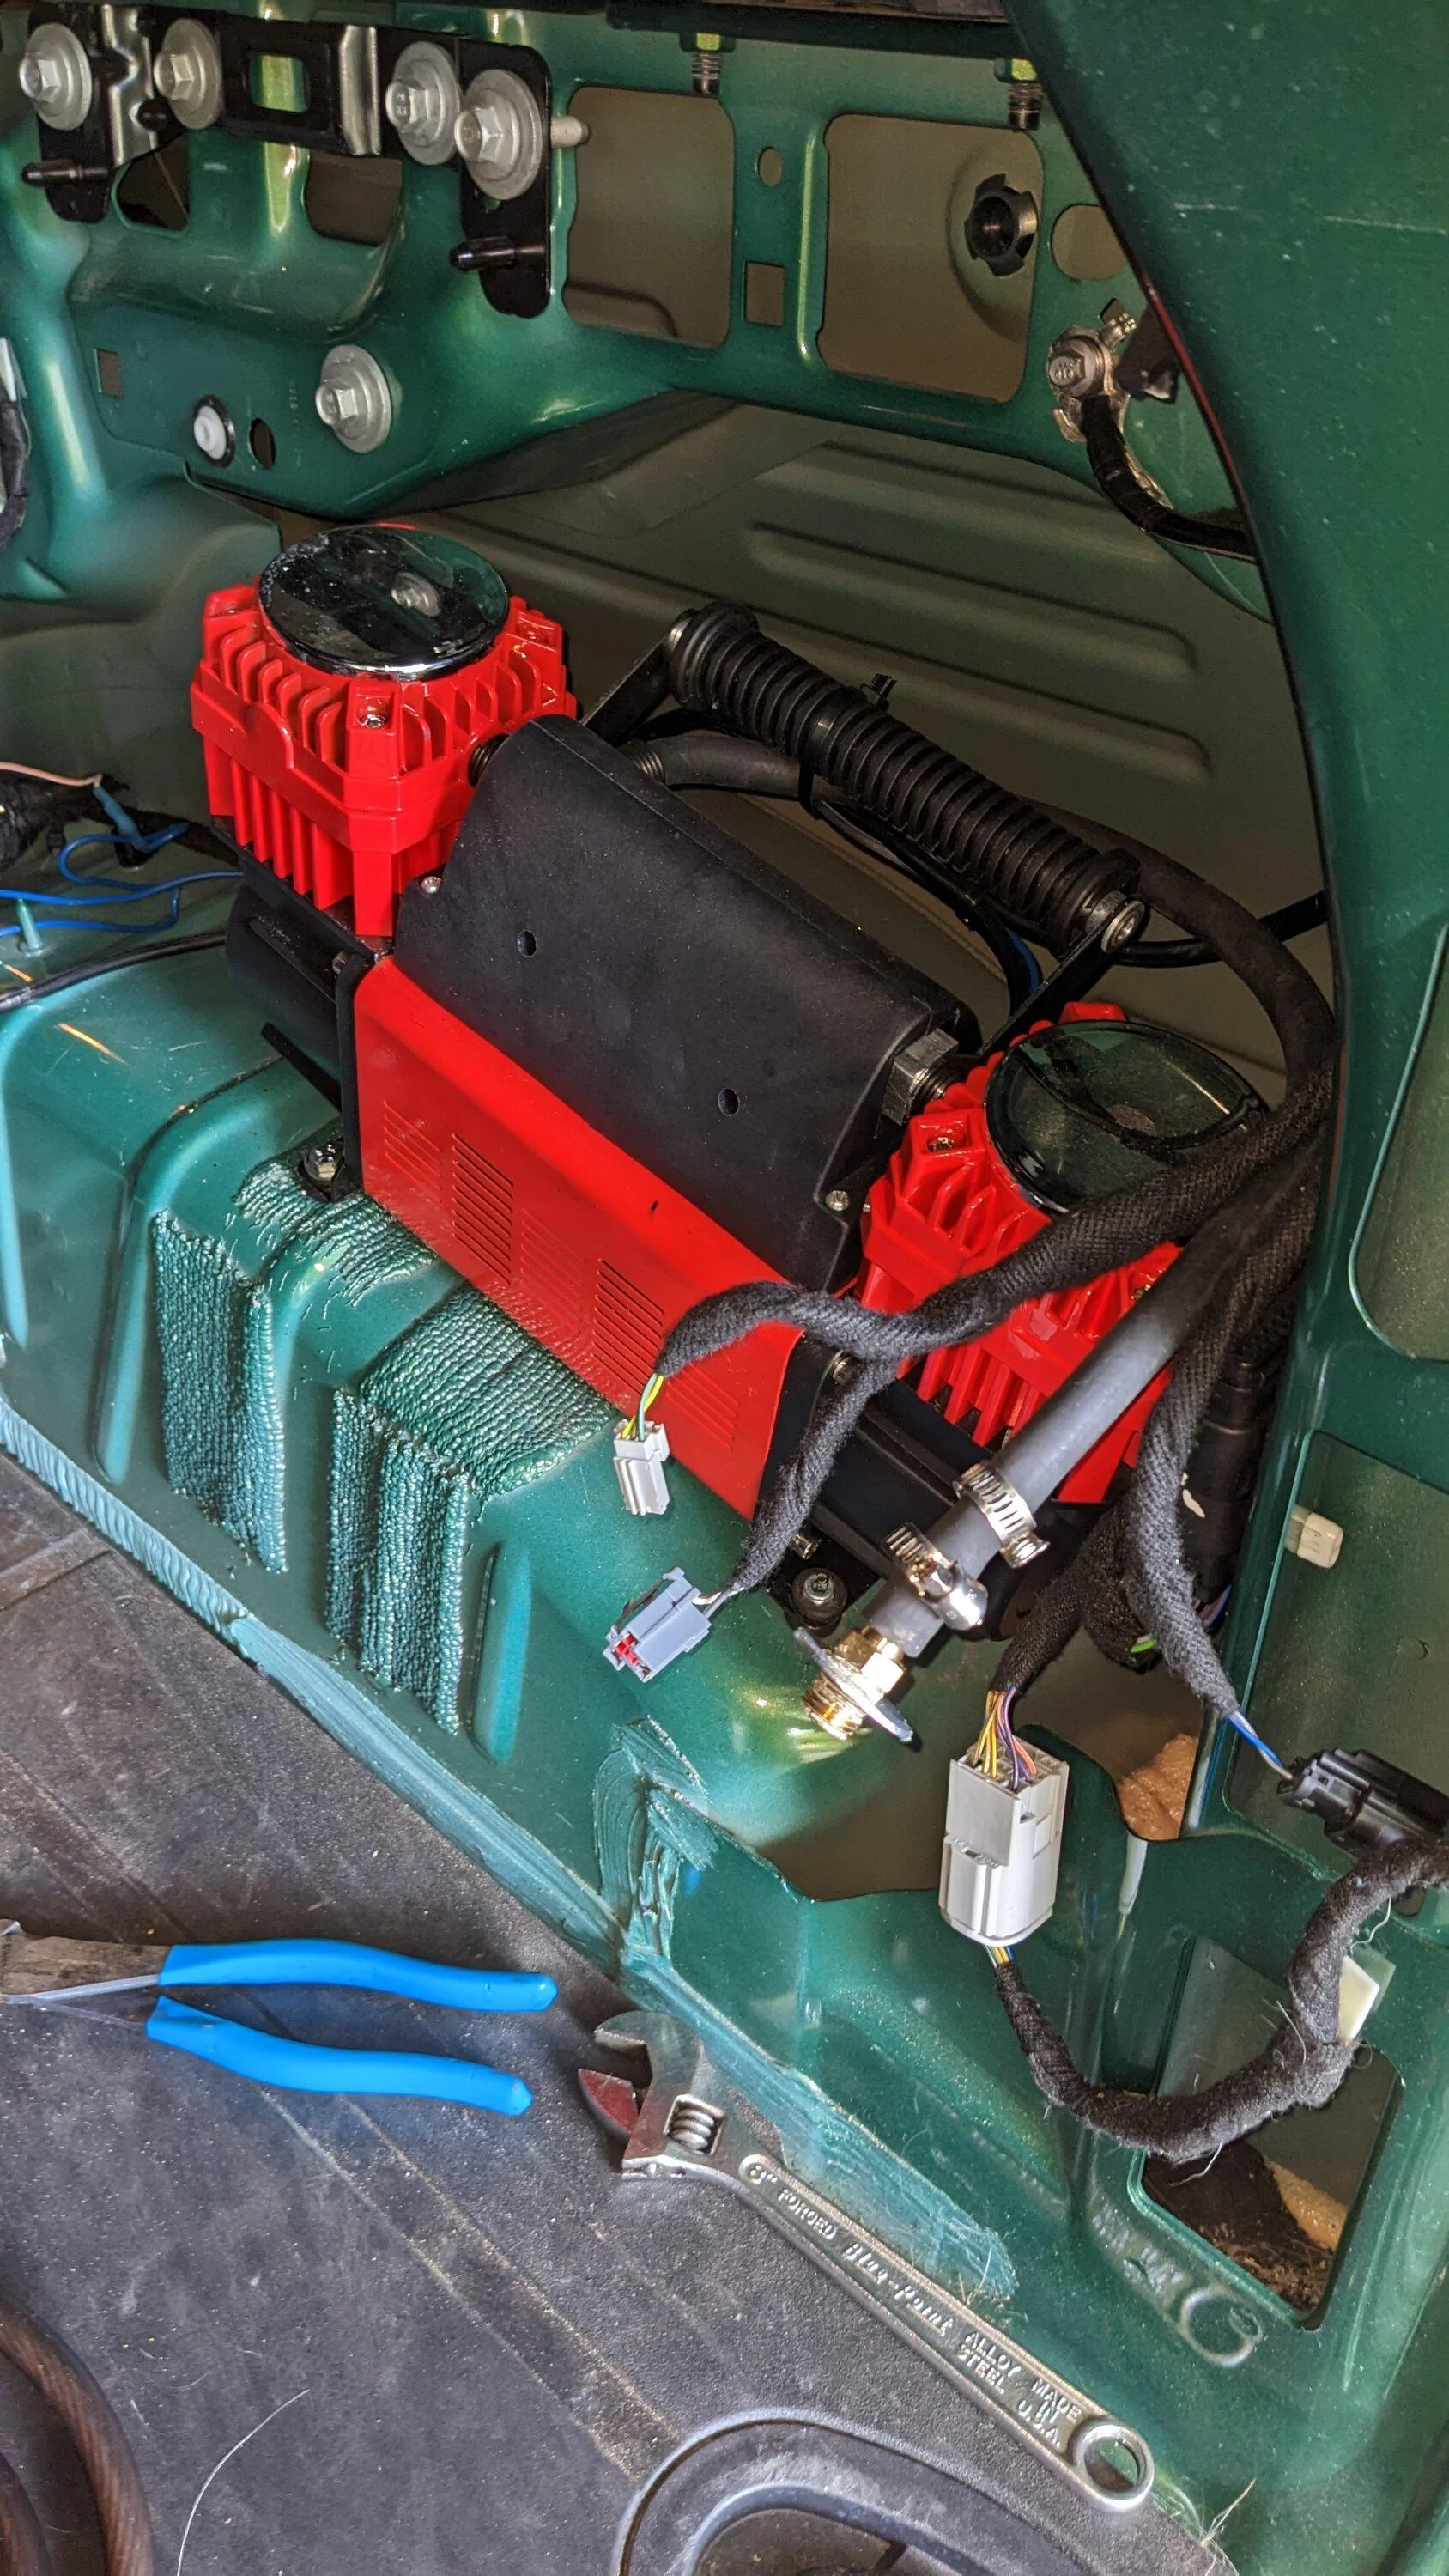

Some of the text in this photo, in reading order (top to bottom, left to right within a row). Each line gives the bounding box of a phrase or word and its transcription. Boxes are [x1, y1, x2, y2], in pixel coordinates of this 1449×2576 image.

[777, 2188, 838, 2239] FORGED
[957, 2343, 1005, 2395] STEEL
[964, 2331, 1022, 2378] ALLOY
[1018, 2399, 1061, 2448] U.S.A.
[1031, 2377, 1082, 2423] MADE
[1038, 2397, 1060, 2424] IN
